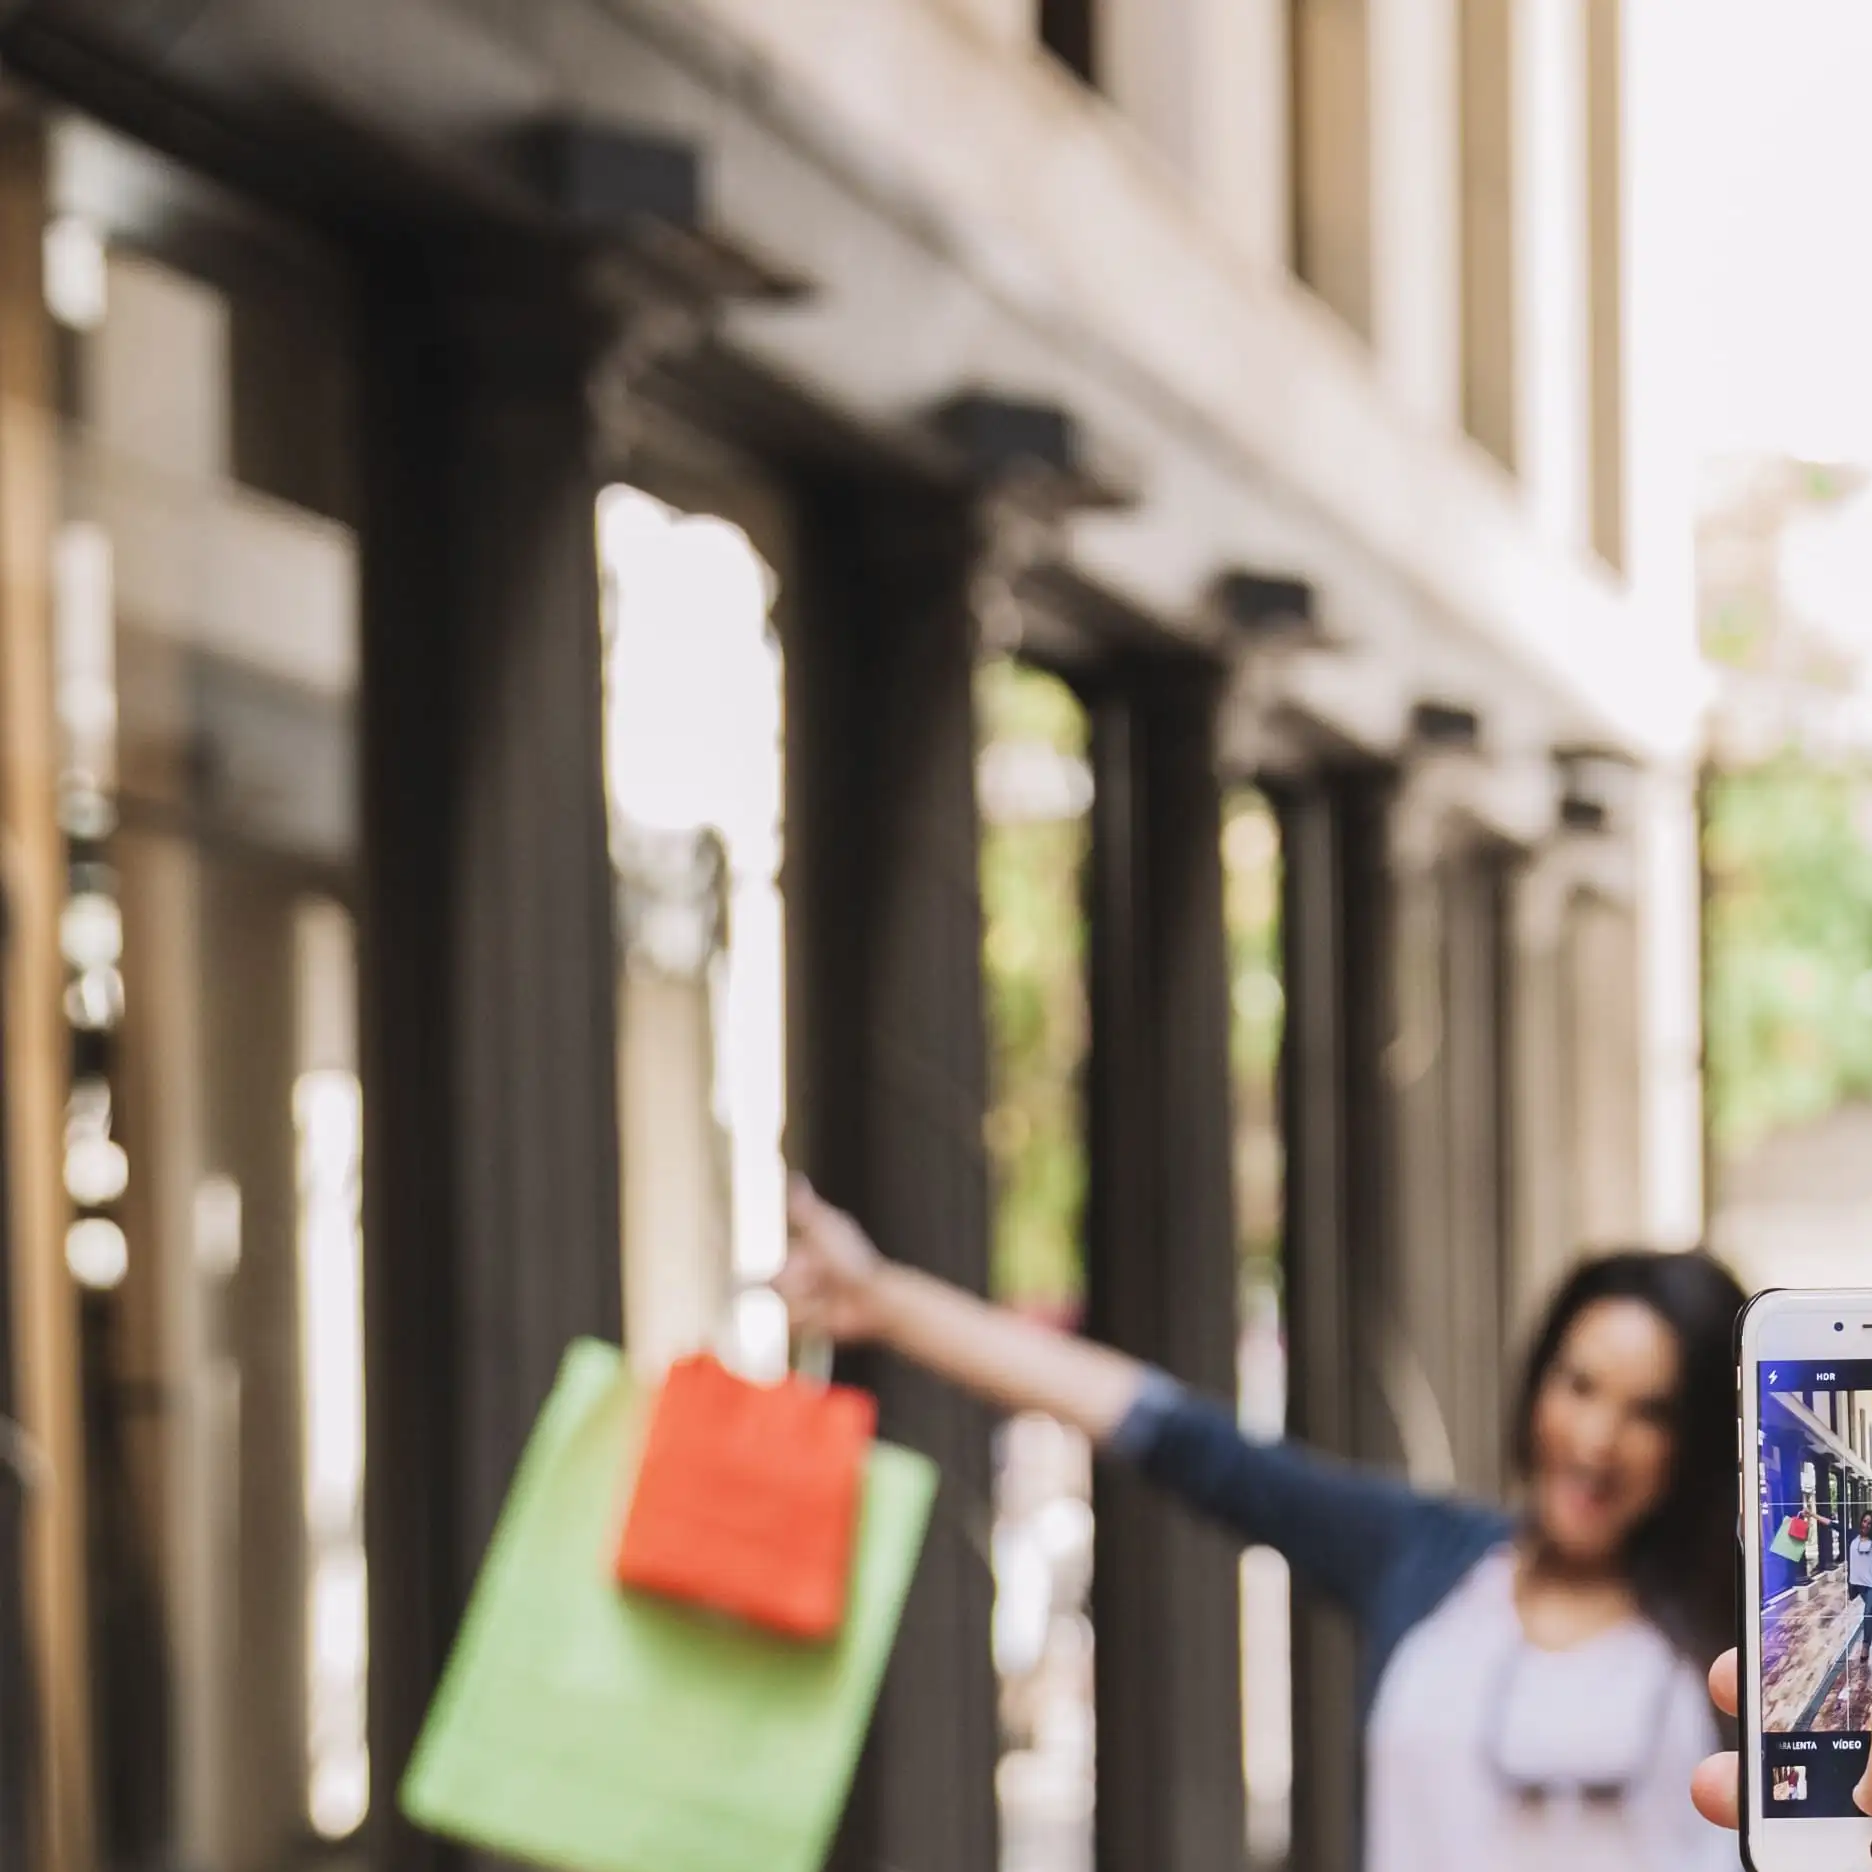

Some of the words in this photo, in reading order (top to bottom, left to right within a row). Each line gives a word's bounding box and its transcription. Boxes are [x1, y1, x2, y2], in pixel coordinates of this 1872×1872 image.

[1816, 1372, 1836, 1381] HDR
[1792, 1741, 1818, 1750] LENTA
[1832, 1738, 1862, 1750] VÍDEO
